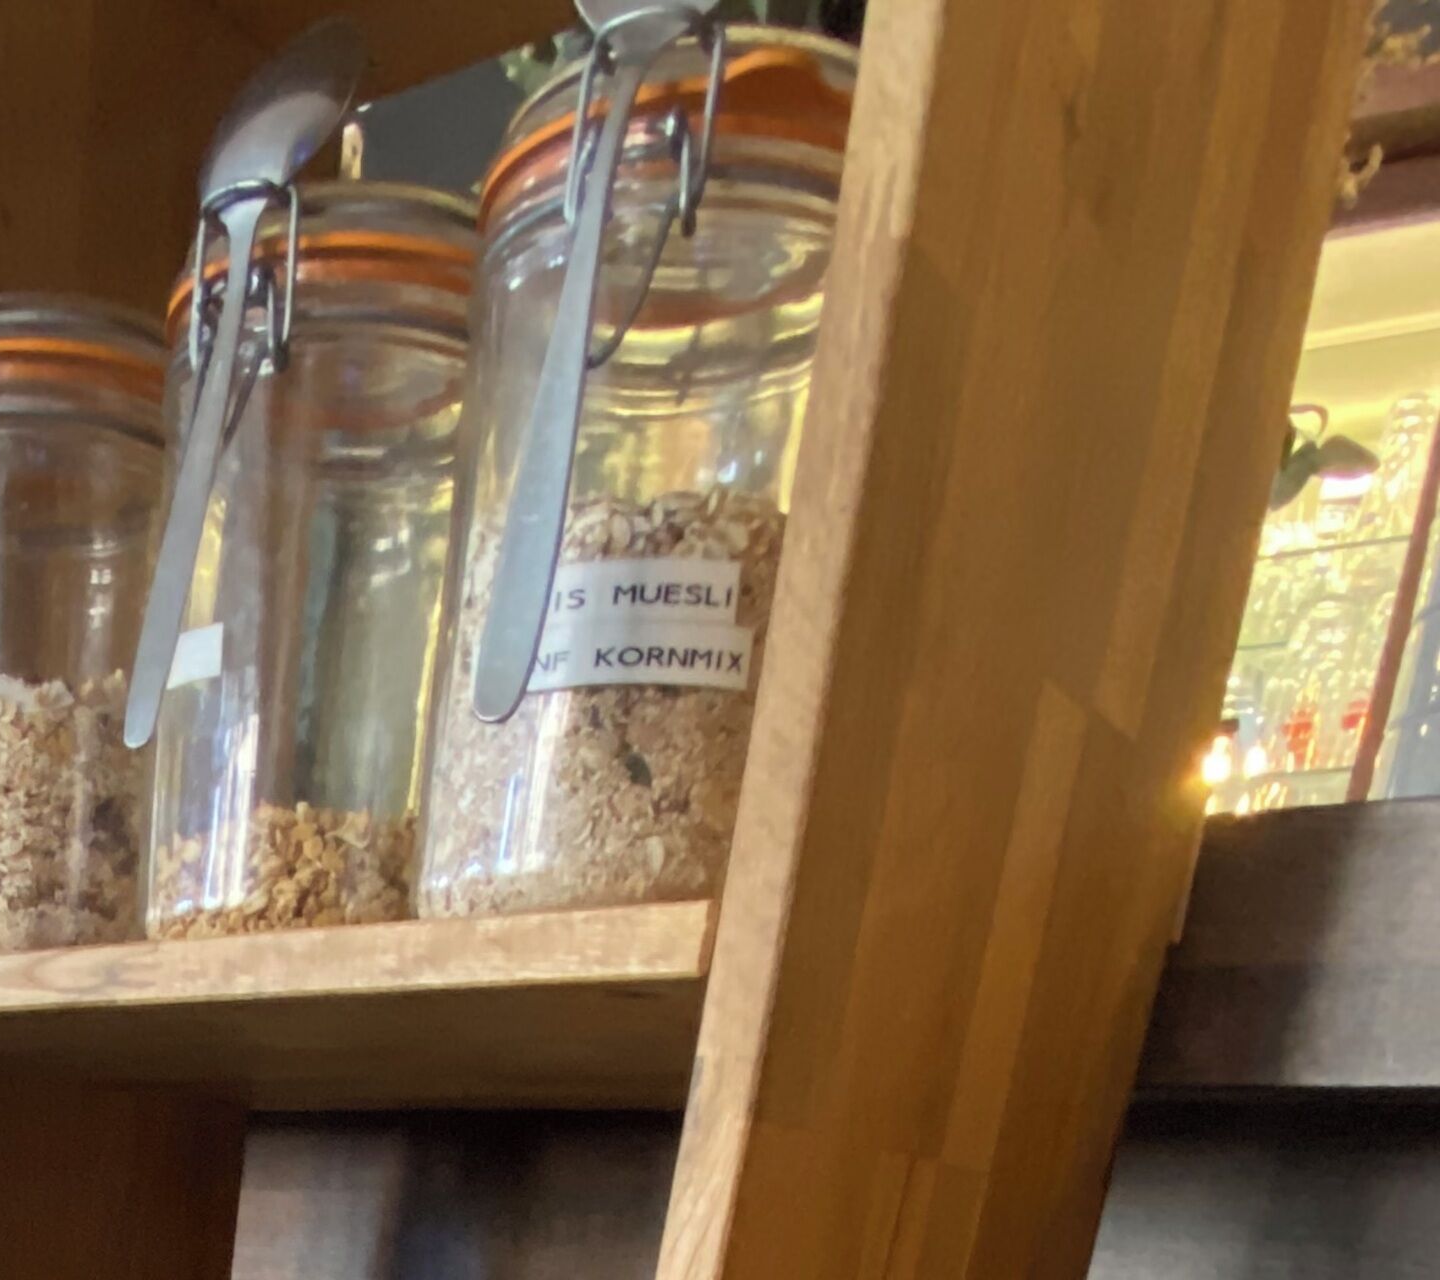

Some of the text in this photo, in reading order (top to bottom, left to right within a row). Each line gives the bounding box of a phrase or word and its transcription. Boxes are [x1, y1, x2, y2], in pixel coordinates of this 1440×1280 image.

[554, 581, 733, 612] IS MUESLI
[537, 645, 744, 675] NF KORNMIX
